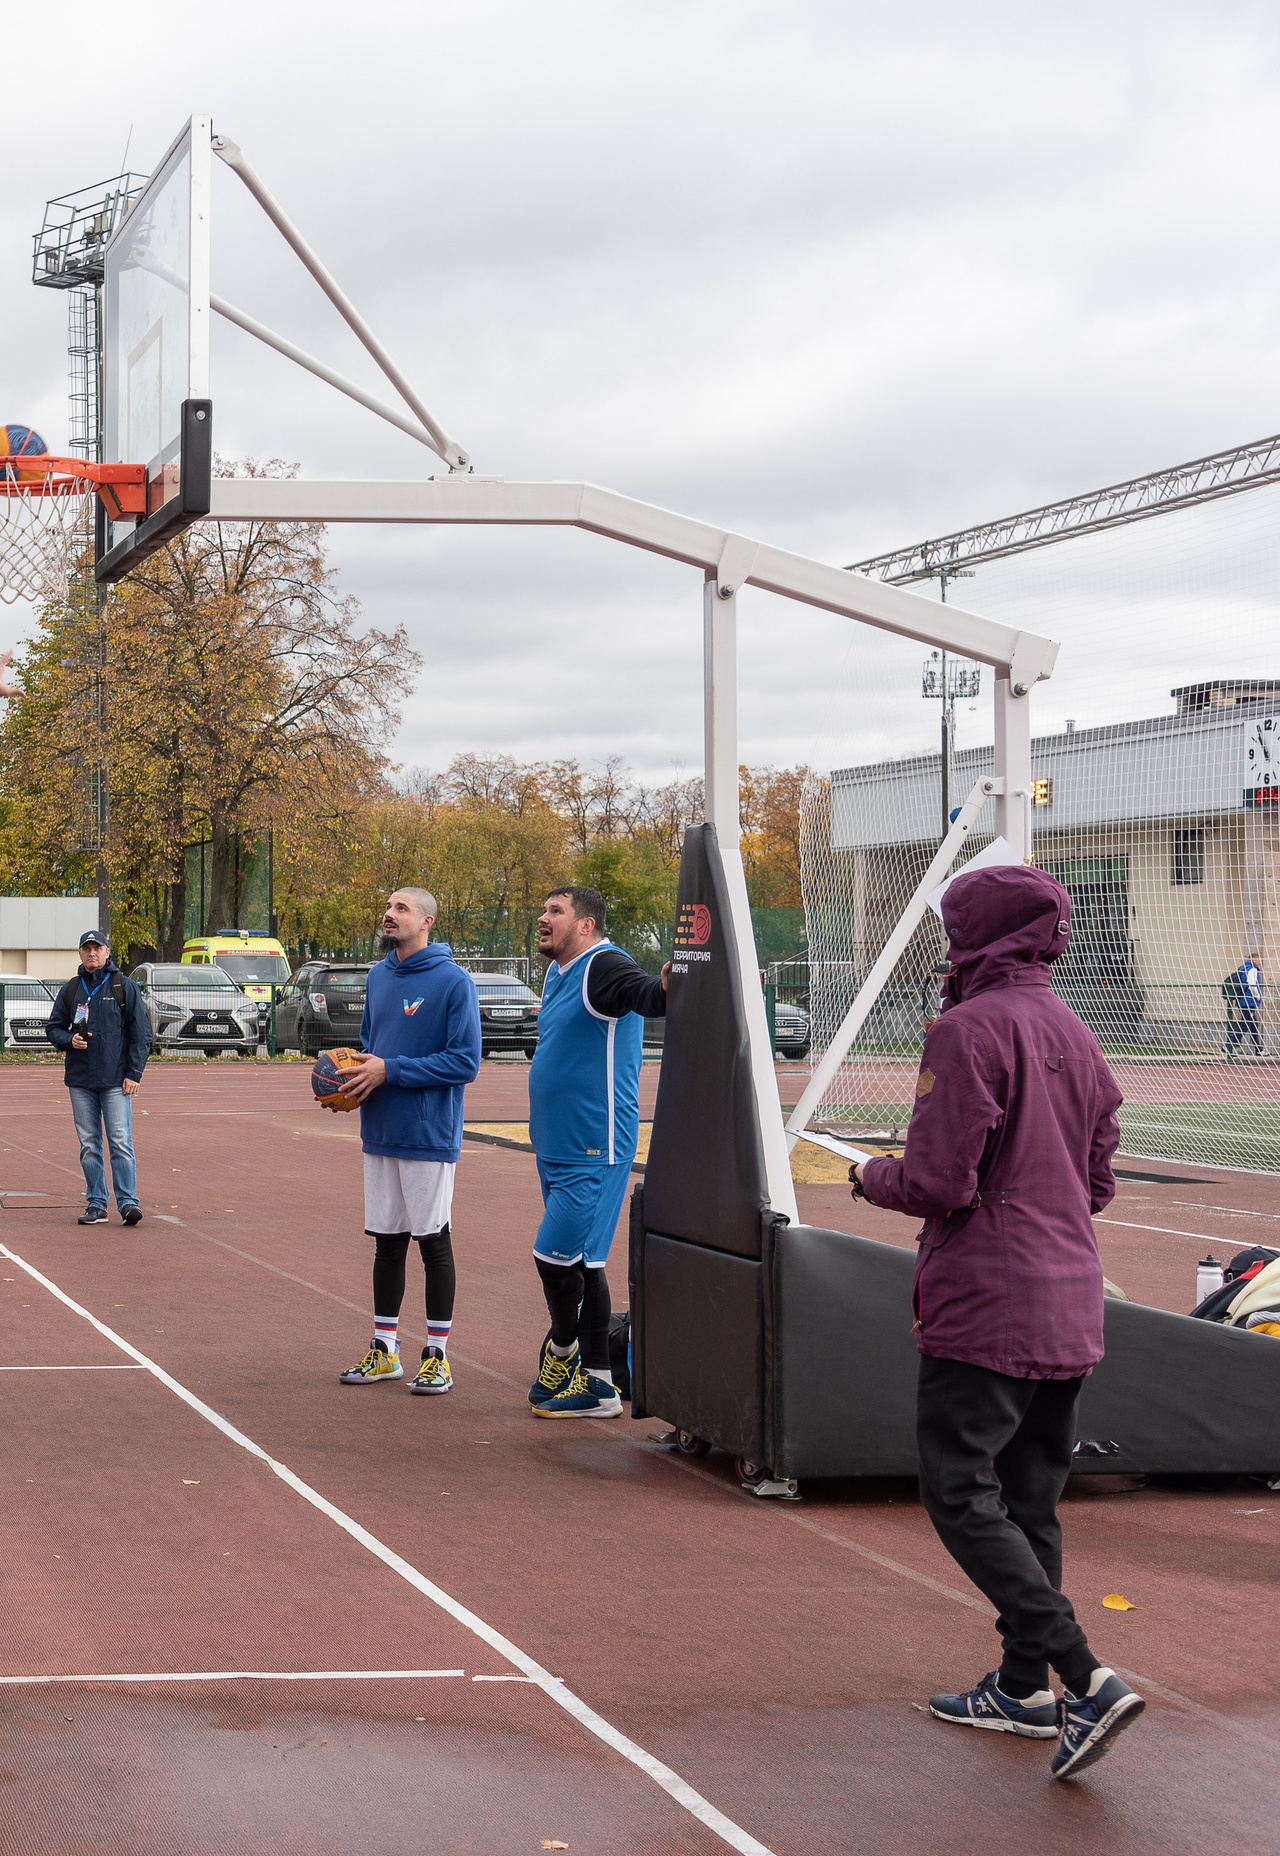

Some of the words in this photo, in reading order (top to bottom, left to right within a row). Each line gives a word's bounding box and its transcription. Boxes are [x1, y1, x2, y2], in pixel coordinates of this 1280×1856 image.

[1264, 719, 1272, 731] 12
[1248, 749, 1255, 760] 9
[1264, 773, 1270, 784] 6
[673, 950, 711, 962] ТЕРРИТОРИЯ
[671, 963, 688, 974] МЯЧА
